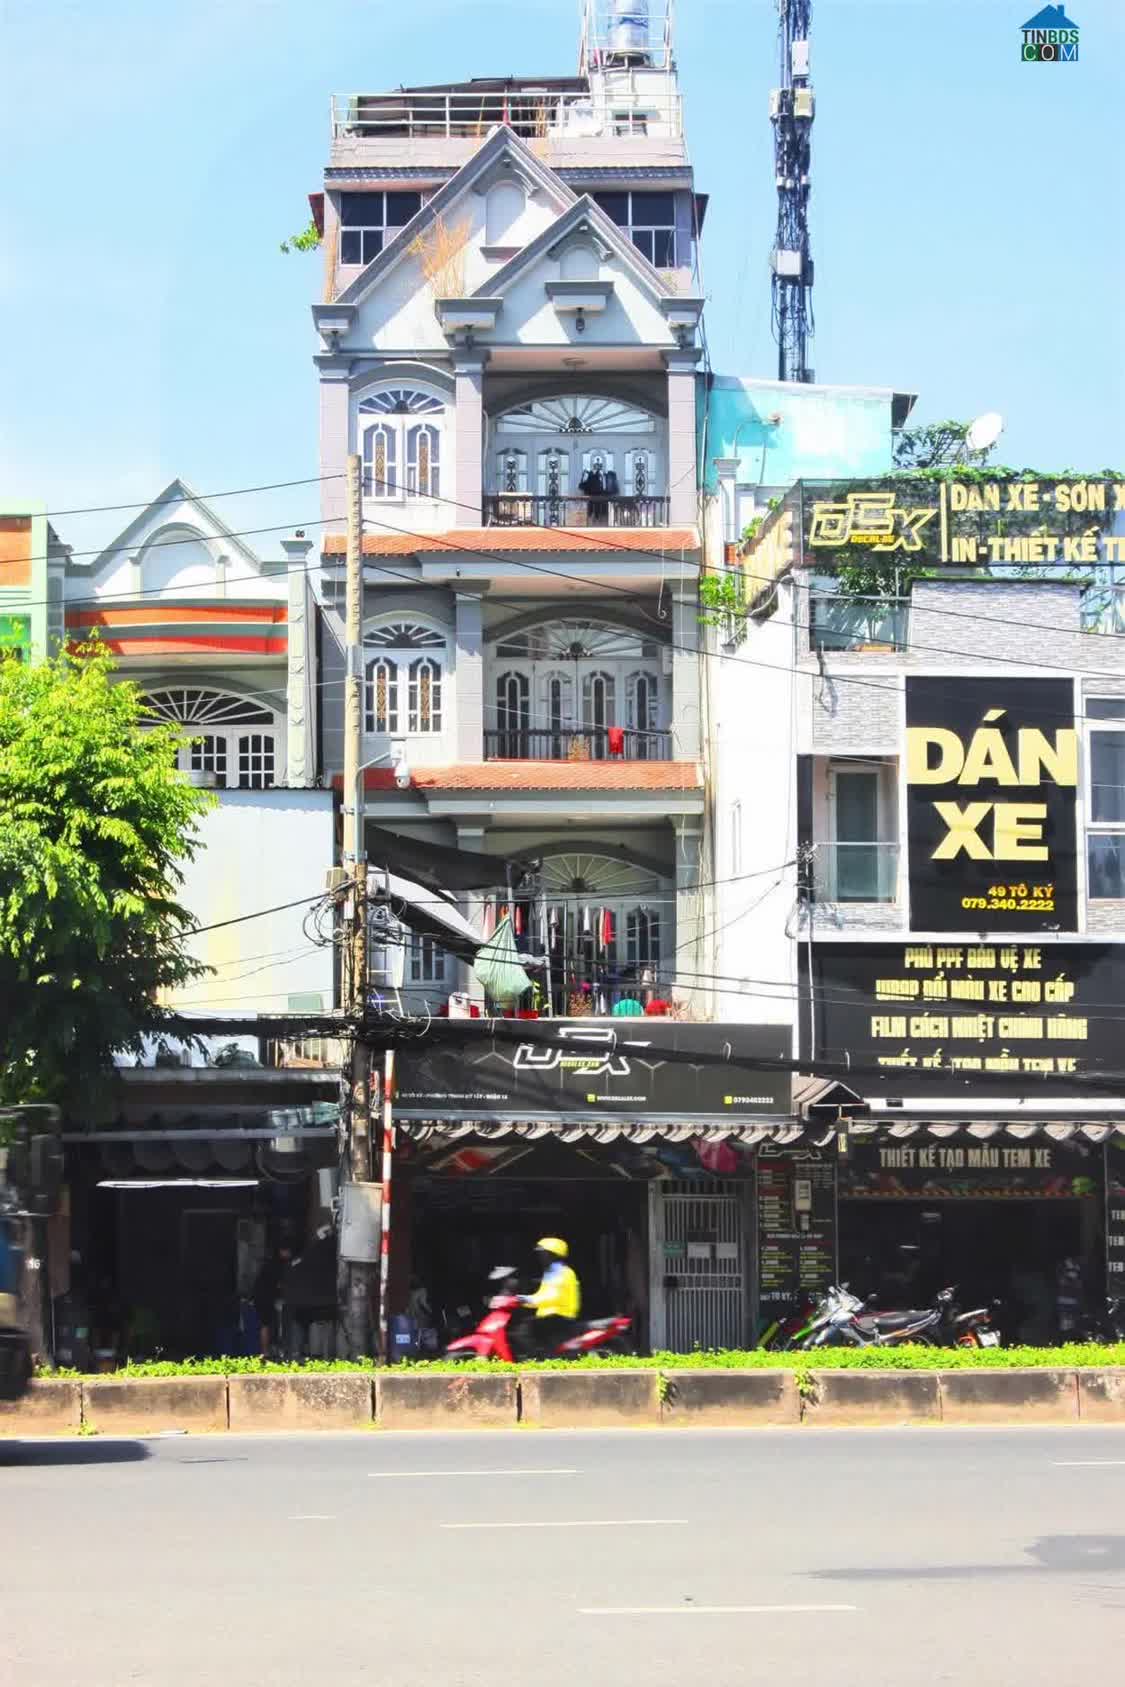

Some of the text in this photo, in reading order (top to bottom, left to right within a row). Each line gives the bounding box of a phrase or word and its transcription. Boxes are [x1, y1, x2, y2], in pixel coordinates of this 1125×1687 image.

[1064, 525, 1100, 562] KẾ
[906, 709, 1079, 786] DÁN
[931, 802, 1049, 861] XE
[988, 883, 1054, 898] 49 TÔ KÝ
[961, 897, 1055, 911] 079.340.2222
[936, 947, 964, 969] PPF
[1023, 948, 1042, 969] XE
[988, 980, 1008, 1002] XE
[879, 1144, 916, 1168] THIẾT
[919, 1143, 937, 1168] KẾ
[1002, 1149, 1030, 1168] TEM
[1034, 1149, 1051, 1168] XE
